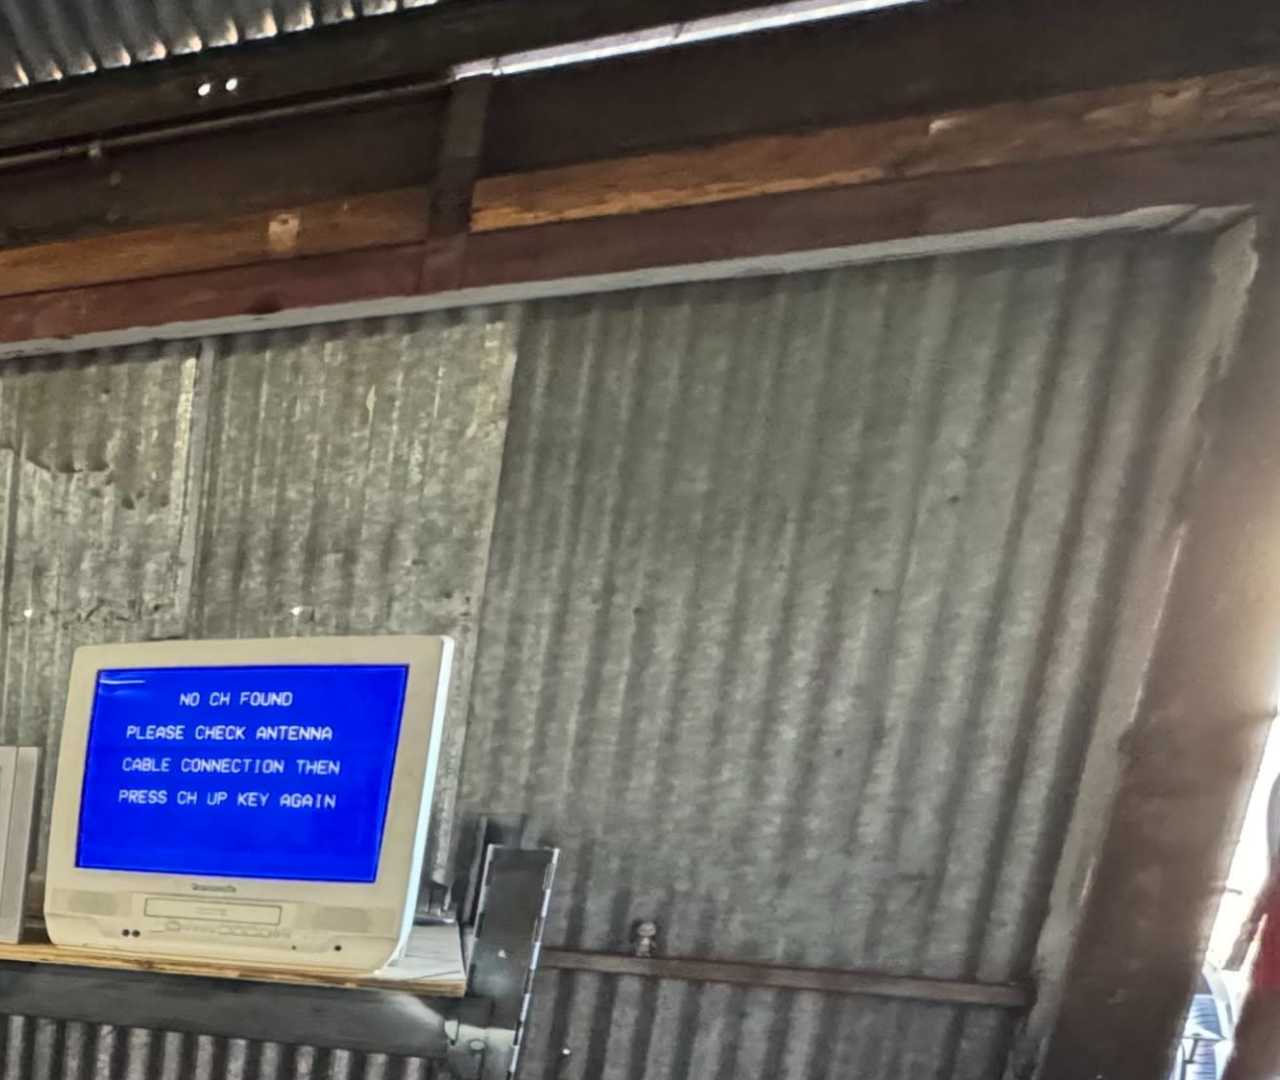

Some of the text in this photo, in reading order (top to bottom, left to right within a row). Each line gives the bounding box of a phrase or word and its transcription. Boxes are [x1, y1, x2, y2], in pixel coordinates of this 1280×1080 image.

[179, 691, 293, 707] NO CH FOUND
[127, 725, 332, 741] PLEASE CHECK ANTENNA
[122, 757, 340, 775] CABLE CONNECTION THEN
[119, 789, 336, 808] PRESS CH UP KEY AGAIN
